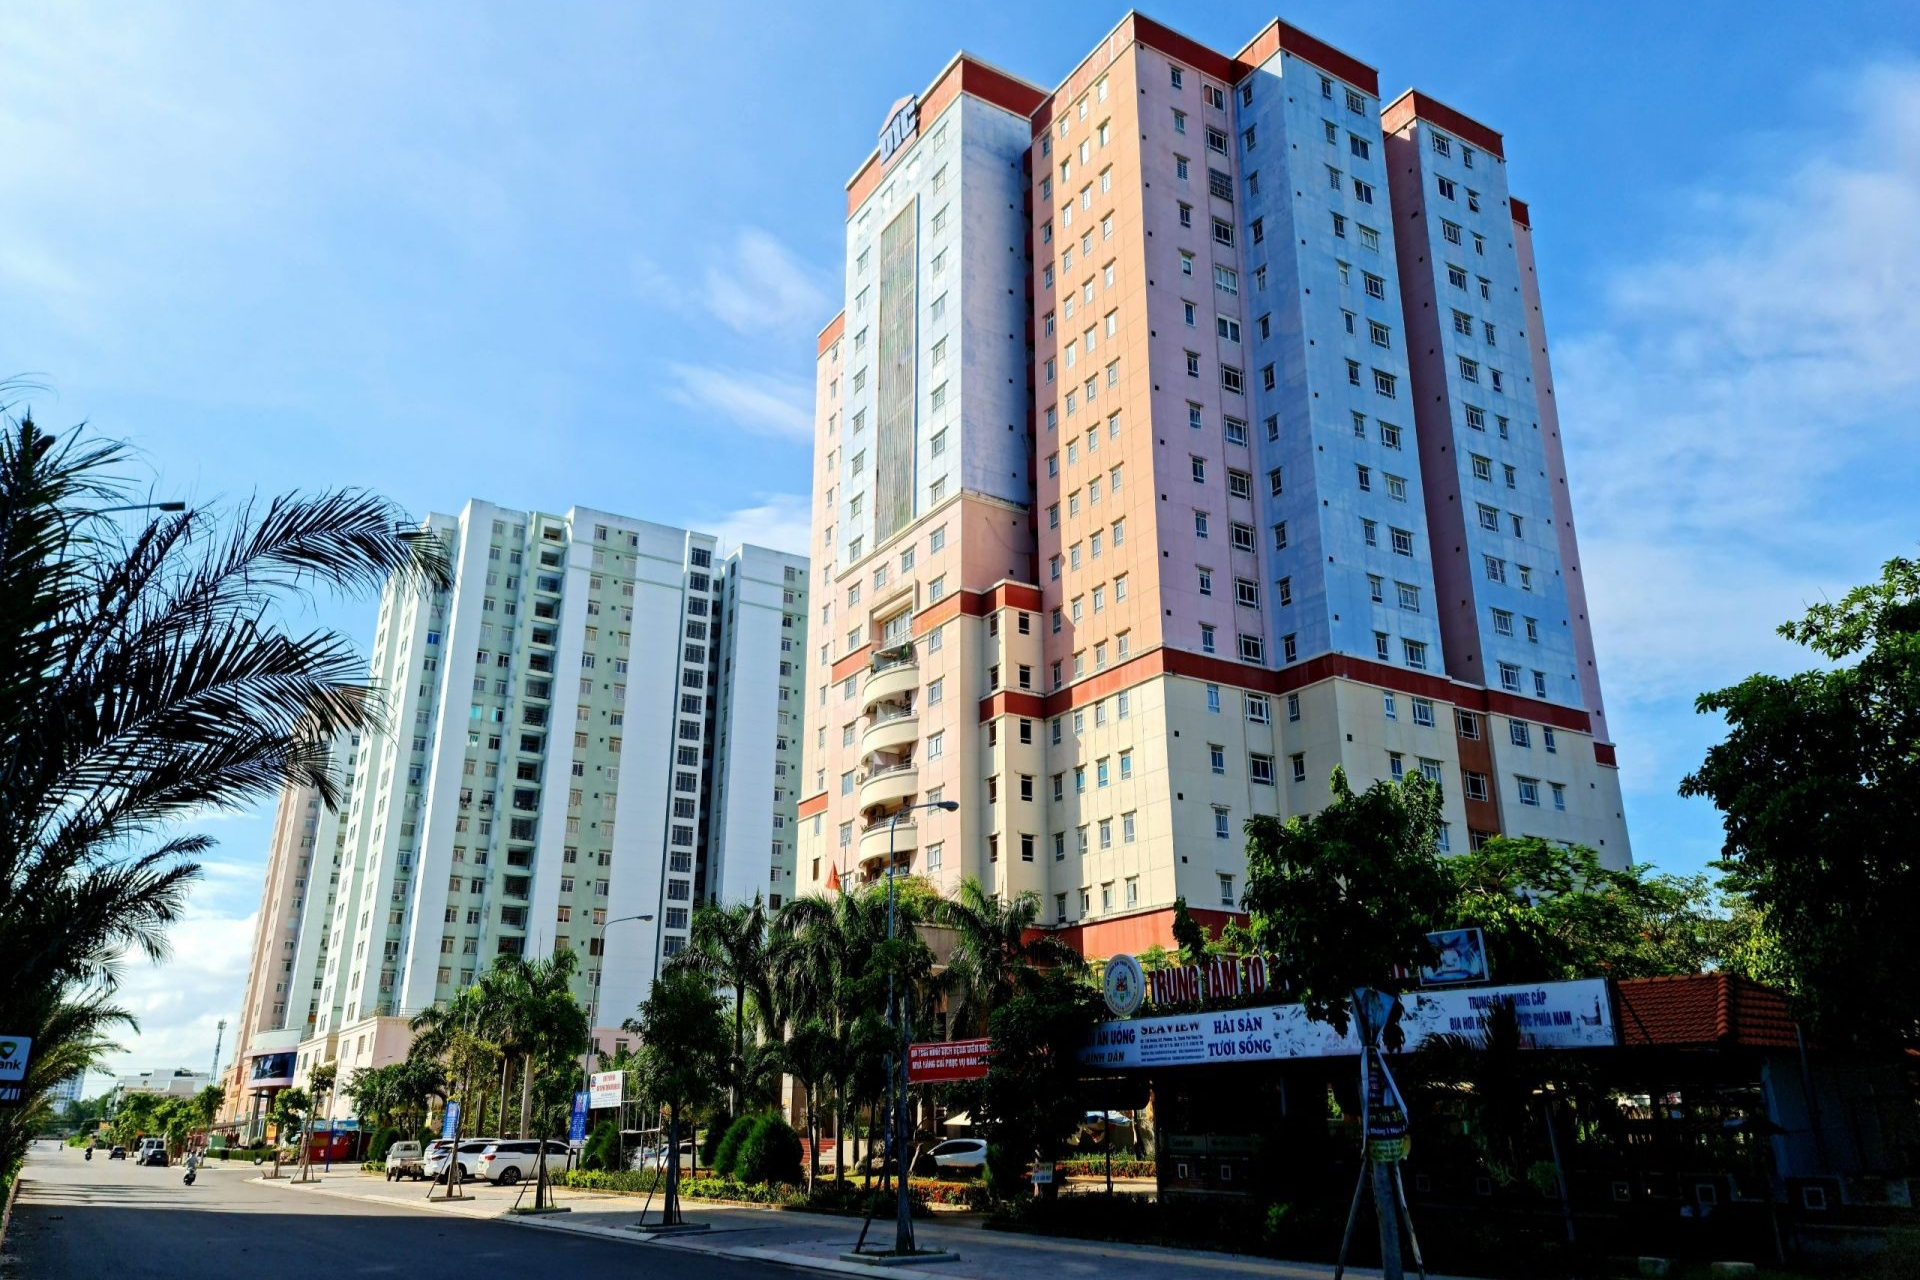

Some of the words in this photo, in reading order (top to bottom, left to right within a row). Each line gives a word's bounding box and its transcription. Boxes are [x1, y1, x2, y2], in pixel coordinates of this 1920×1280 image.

[1147, 965, 1201, 1003] TRUNG
[1468, 994, 1491, 1010] TRUNG
[1509, 992, 1531, 1007] UNG
[1531, 986, 1547, 1006] CẤP
[1213, 1014, 1236, 1035] HẢI
[1237, 1011, 1263, 1032] SẢN
[1449, 1016, 1462, 1031] BIA
[1552, 1010, 1572, 1026] NAM
[1110, 1022, 1136, 1046] UỐNG
[1207, 1039, 1237, 1057] TƯƠI
[1238, 1033, 1272, 1055] SỐNG
